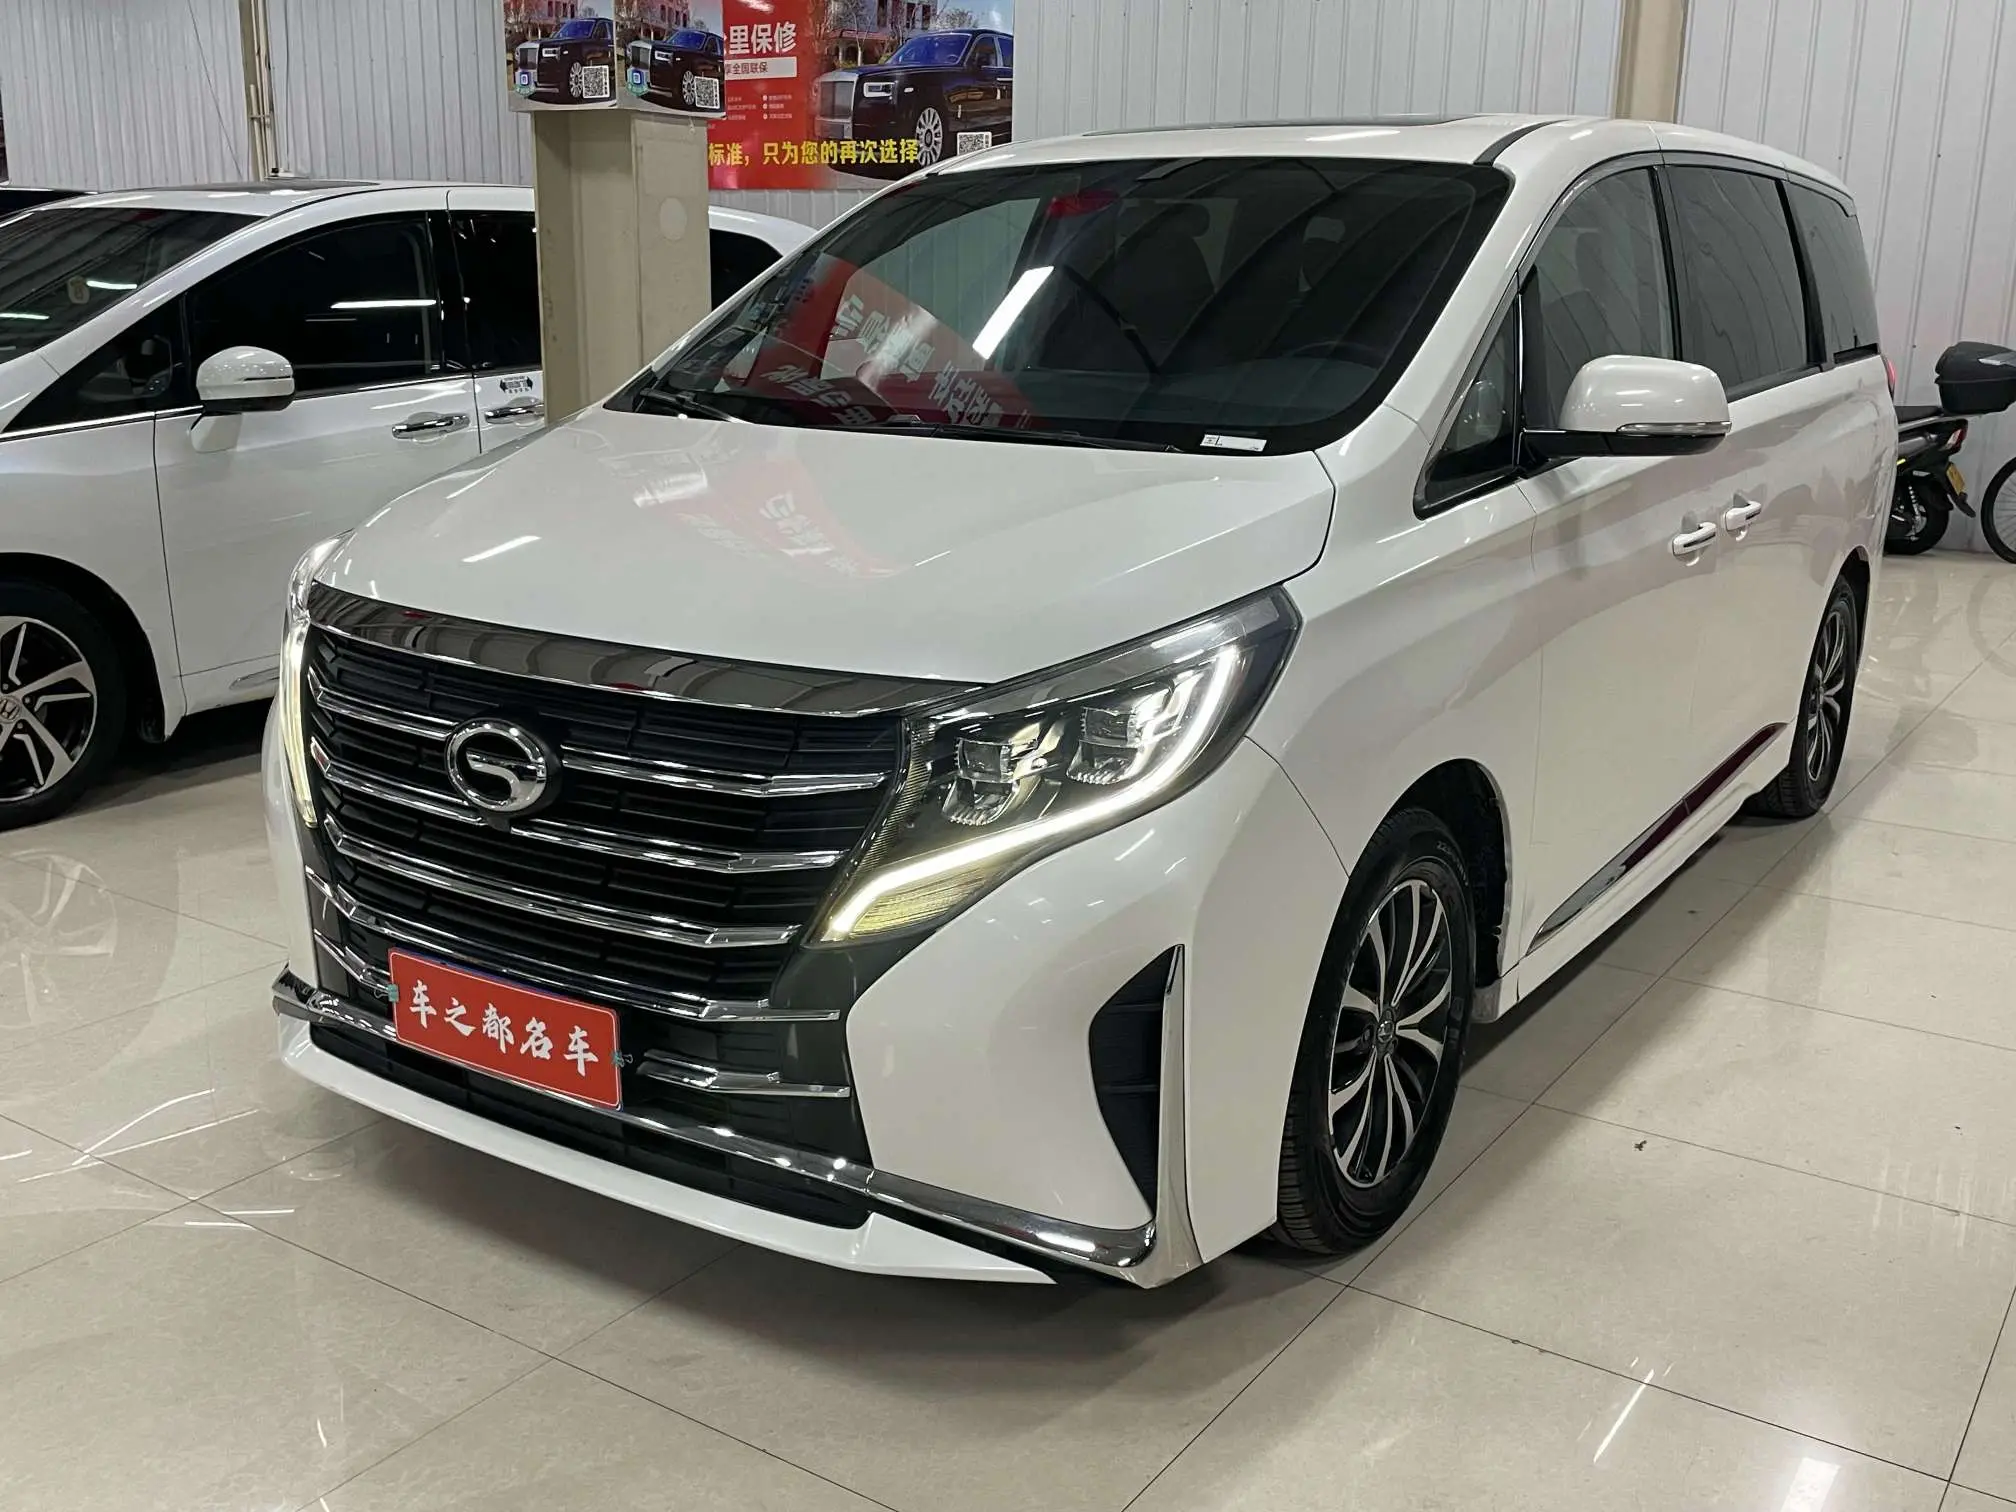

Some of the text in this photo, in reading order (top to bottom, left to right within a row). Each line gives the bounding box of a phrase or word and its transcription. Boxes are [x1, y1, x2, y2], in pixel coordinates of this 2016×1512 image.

[724, 21, 797, 55] 里保修
[708, 138, 918, 167] 标准，只为您的再次选择
[409, 979, 599, 1077] 车之都名车
